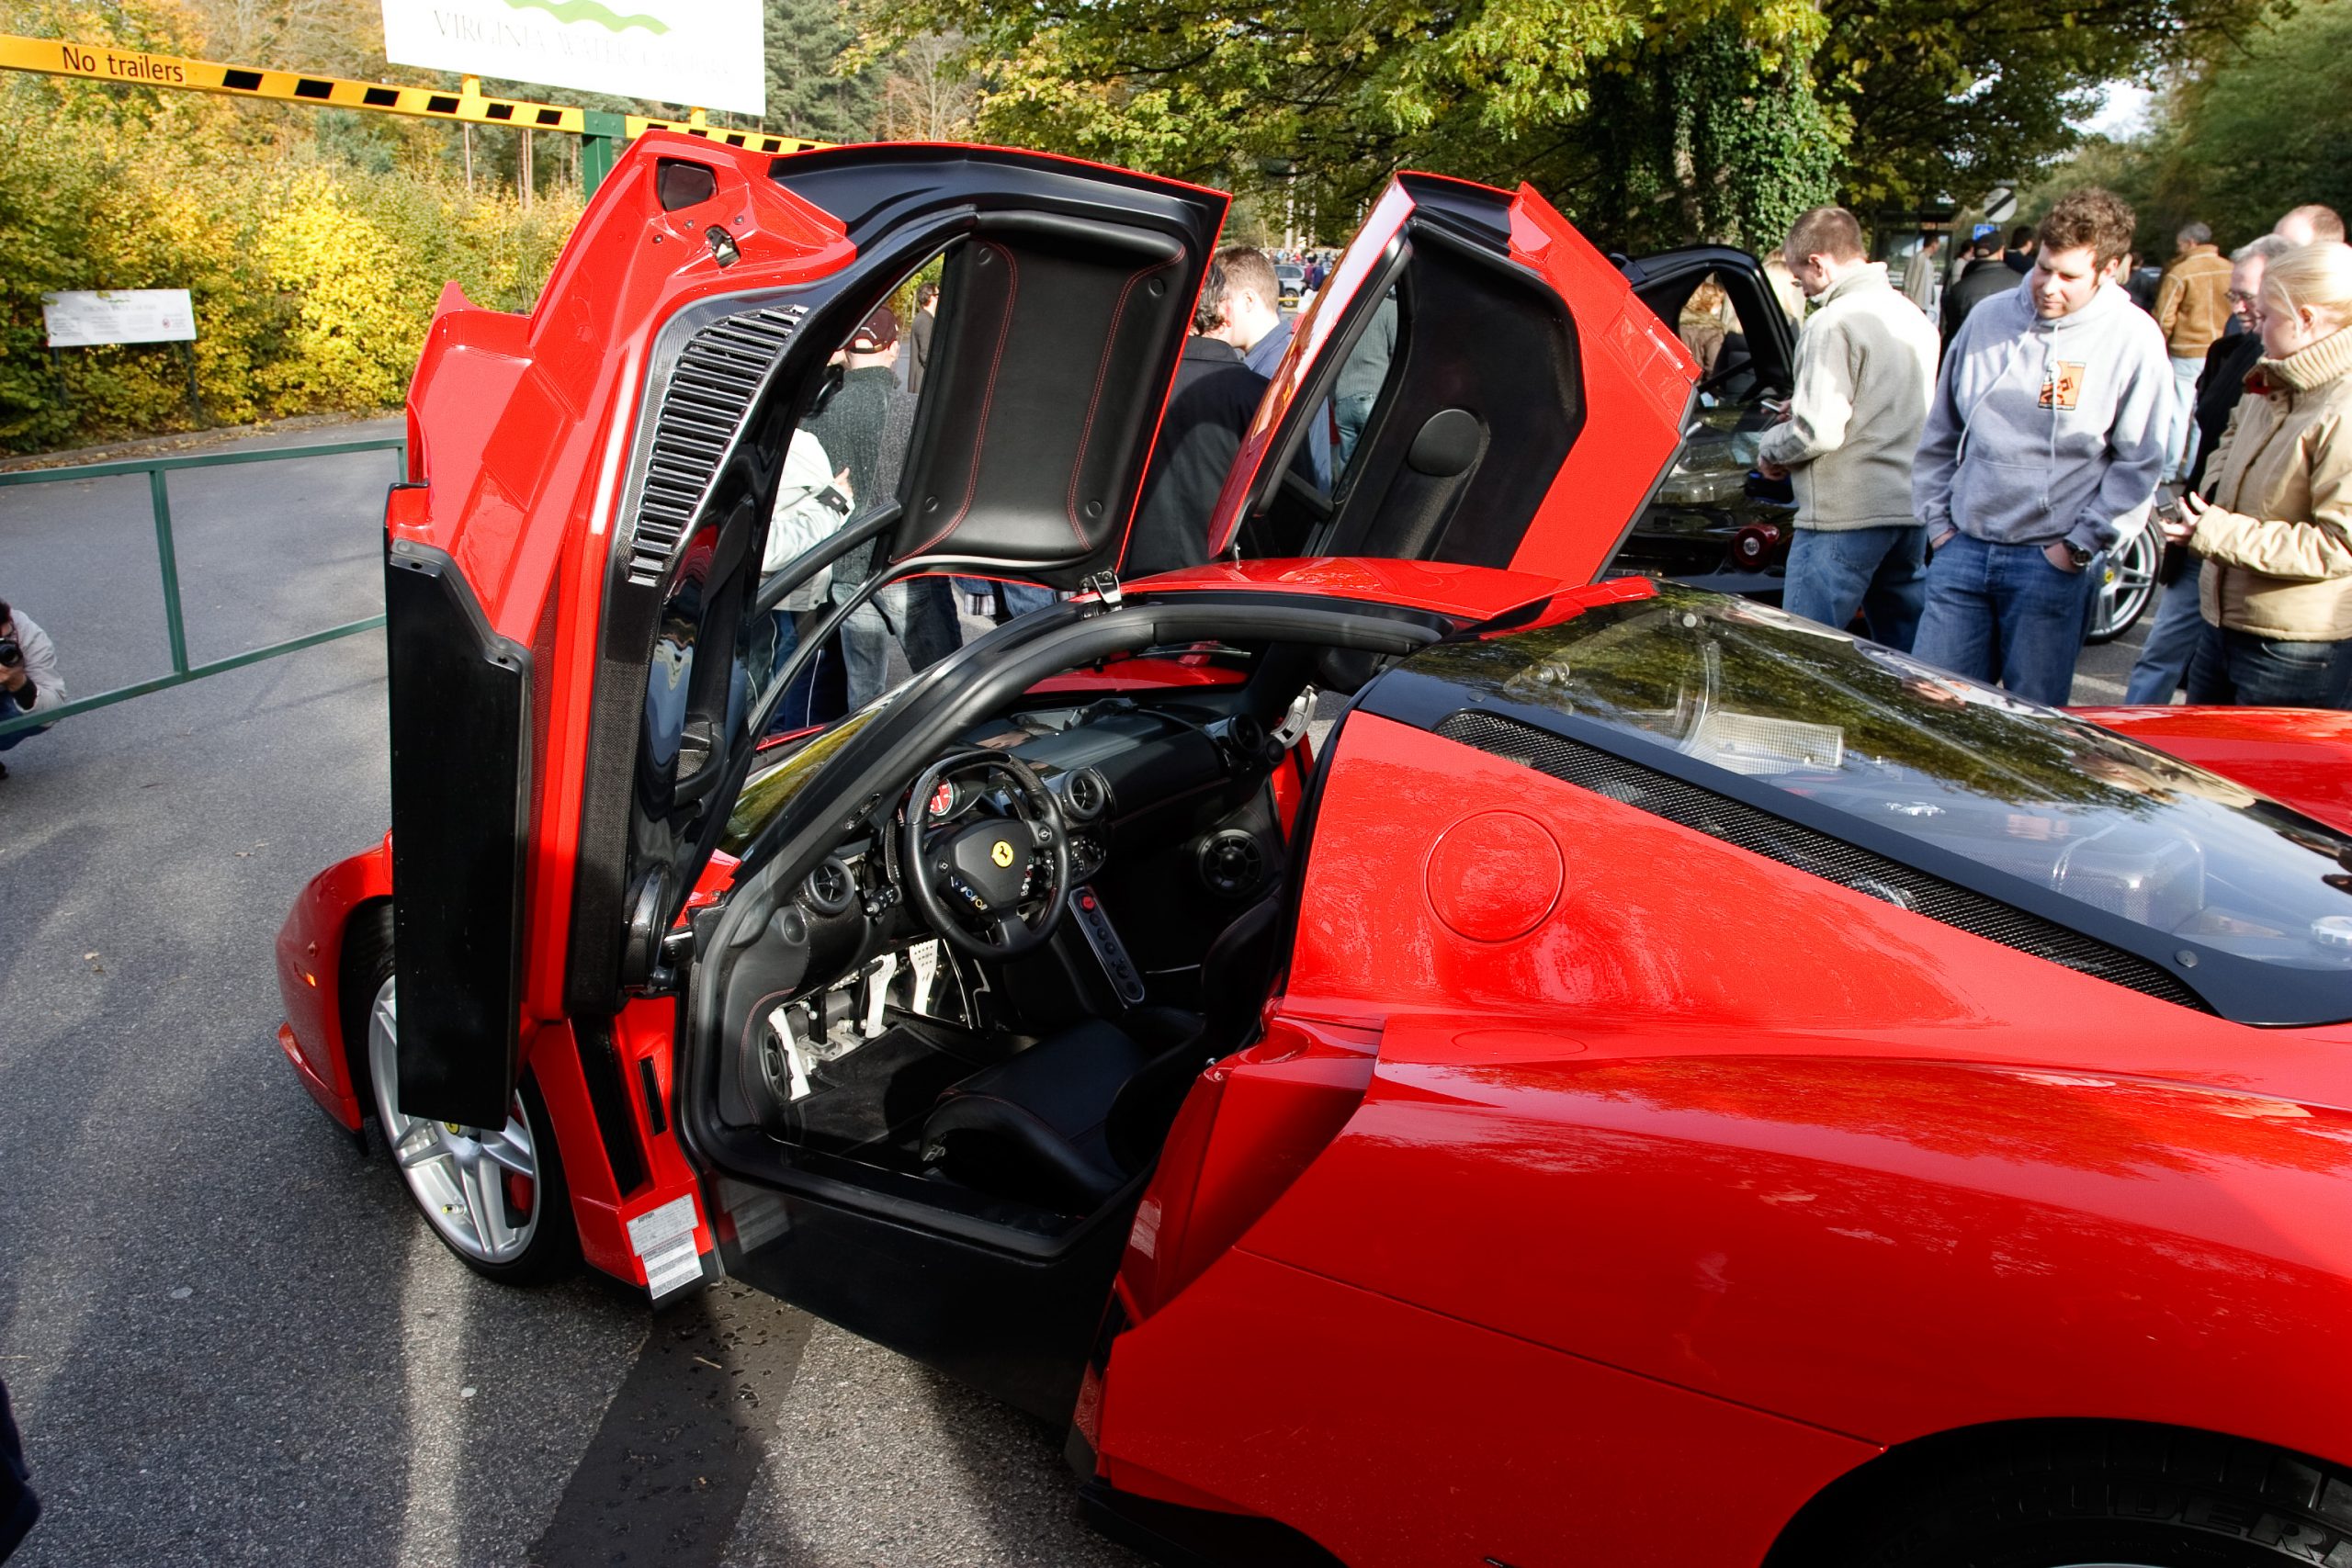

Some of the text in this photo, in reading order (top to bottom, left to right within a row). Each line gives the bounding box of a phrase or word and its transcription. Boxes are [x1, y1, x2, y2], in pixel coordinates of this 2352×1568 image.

[433, 9, 546, 53] VIRGINIA
[62, 46, 184, 83] No trailers
